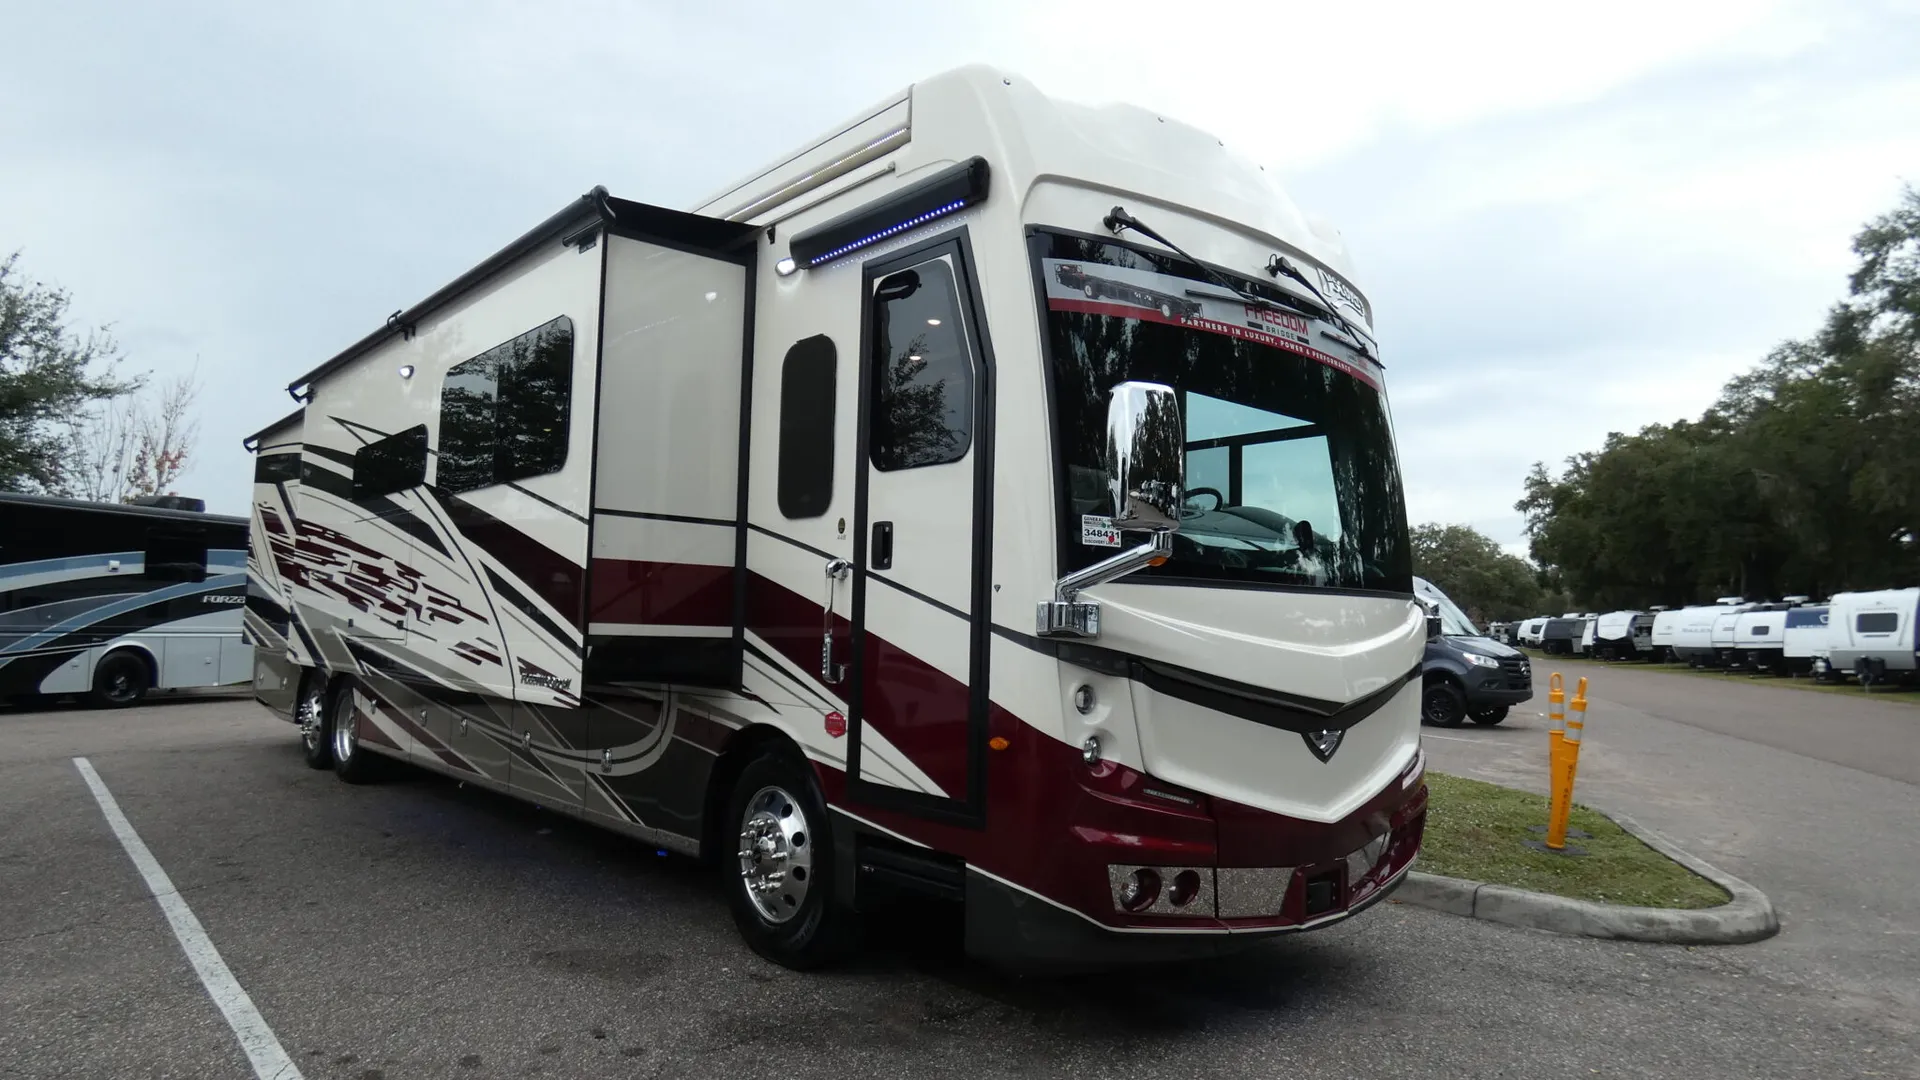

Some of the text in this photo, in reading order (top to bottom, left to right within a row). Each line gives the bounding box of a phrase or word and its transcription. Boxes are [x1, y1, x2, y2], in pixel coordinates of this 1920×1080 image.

[1244, 303, 1308, 336] FREEDOM
[1265, 325, 1295, 340] BRIDGE
[1181, 317, 1228, 333] PARTNERS
[1231, 327, 1241, 336] IN
[1244, 330, 1278, 346] LUXURY,
[1280, 340, 1304, 353] POWER
[1312, 351, 1351, 373] PERFORMANCE
